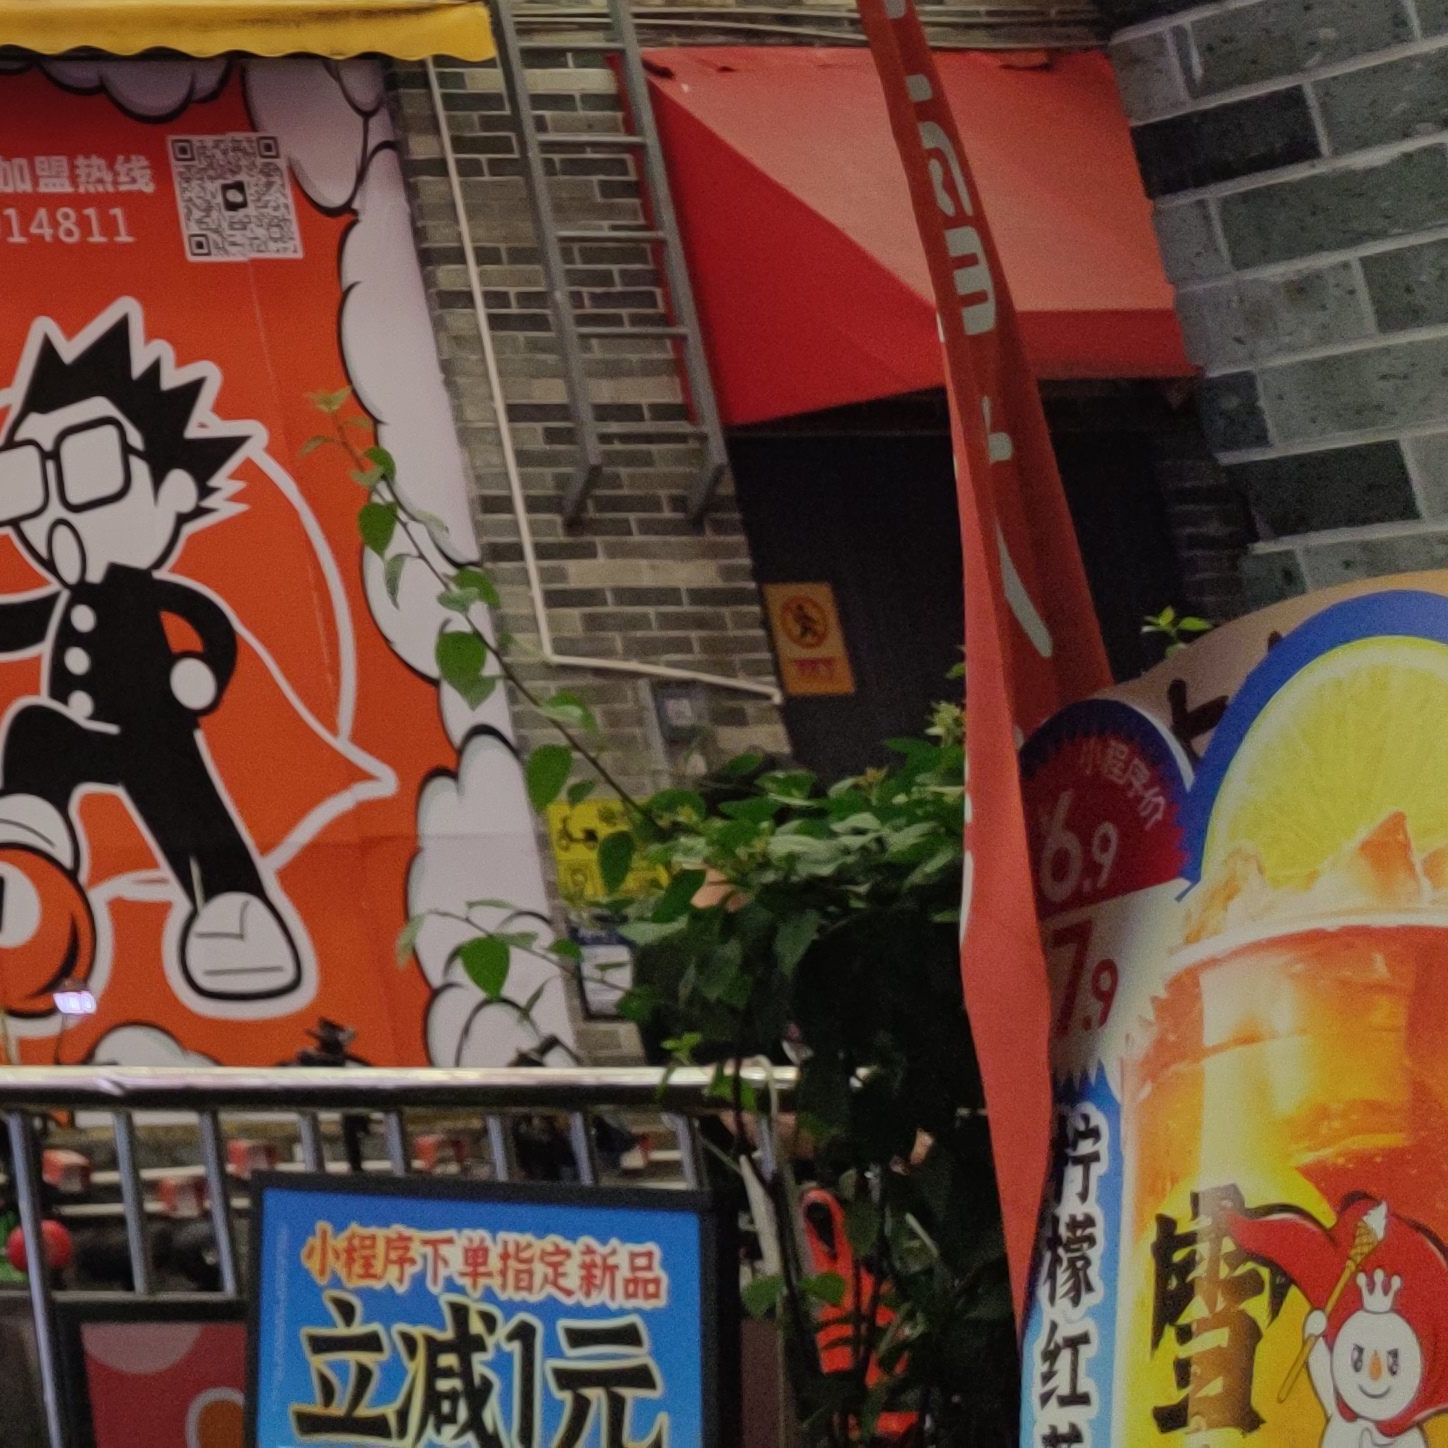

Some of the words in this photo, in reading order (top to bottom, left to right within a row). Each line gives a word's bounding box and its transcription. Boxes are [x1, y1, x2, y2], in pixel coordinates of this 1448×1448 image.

[305, 1222, 664, 1303] 小程序下单指定新品
[292, 1292, 668, 1448] 立减1元
